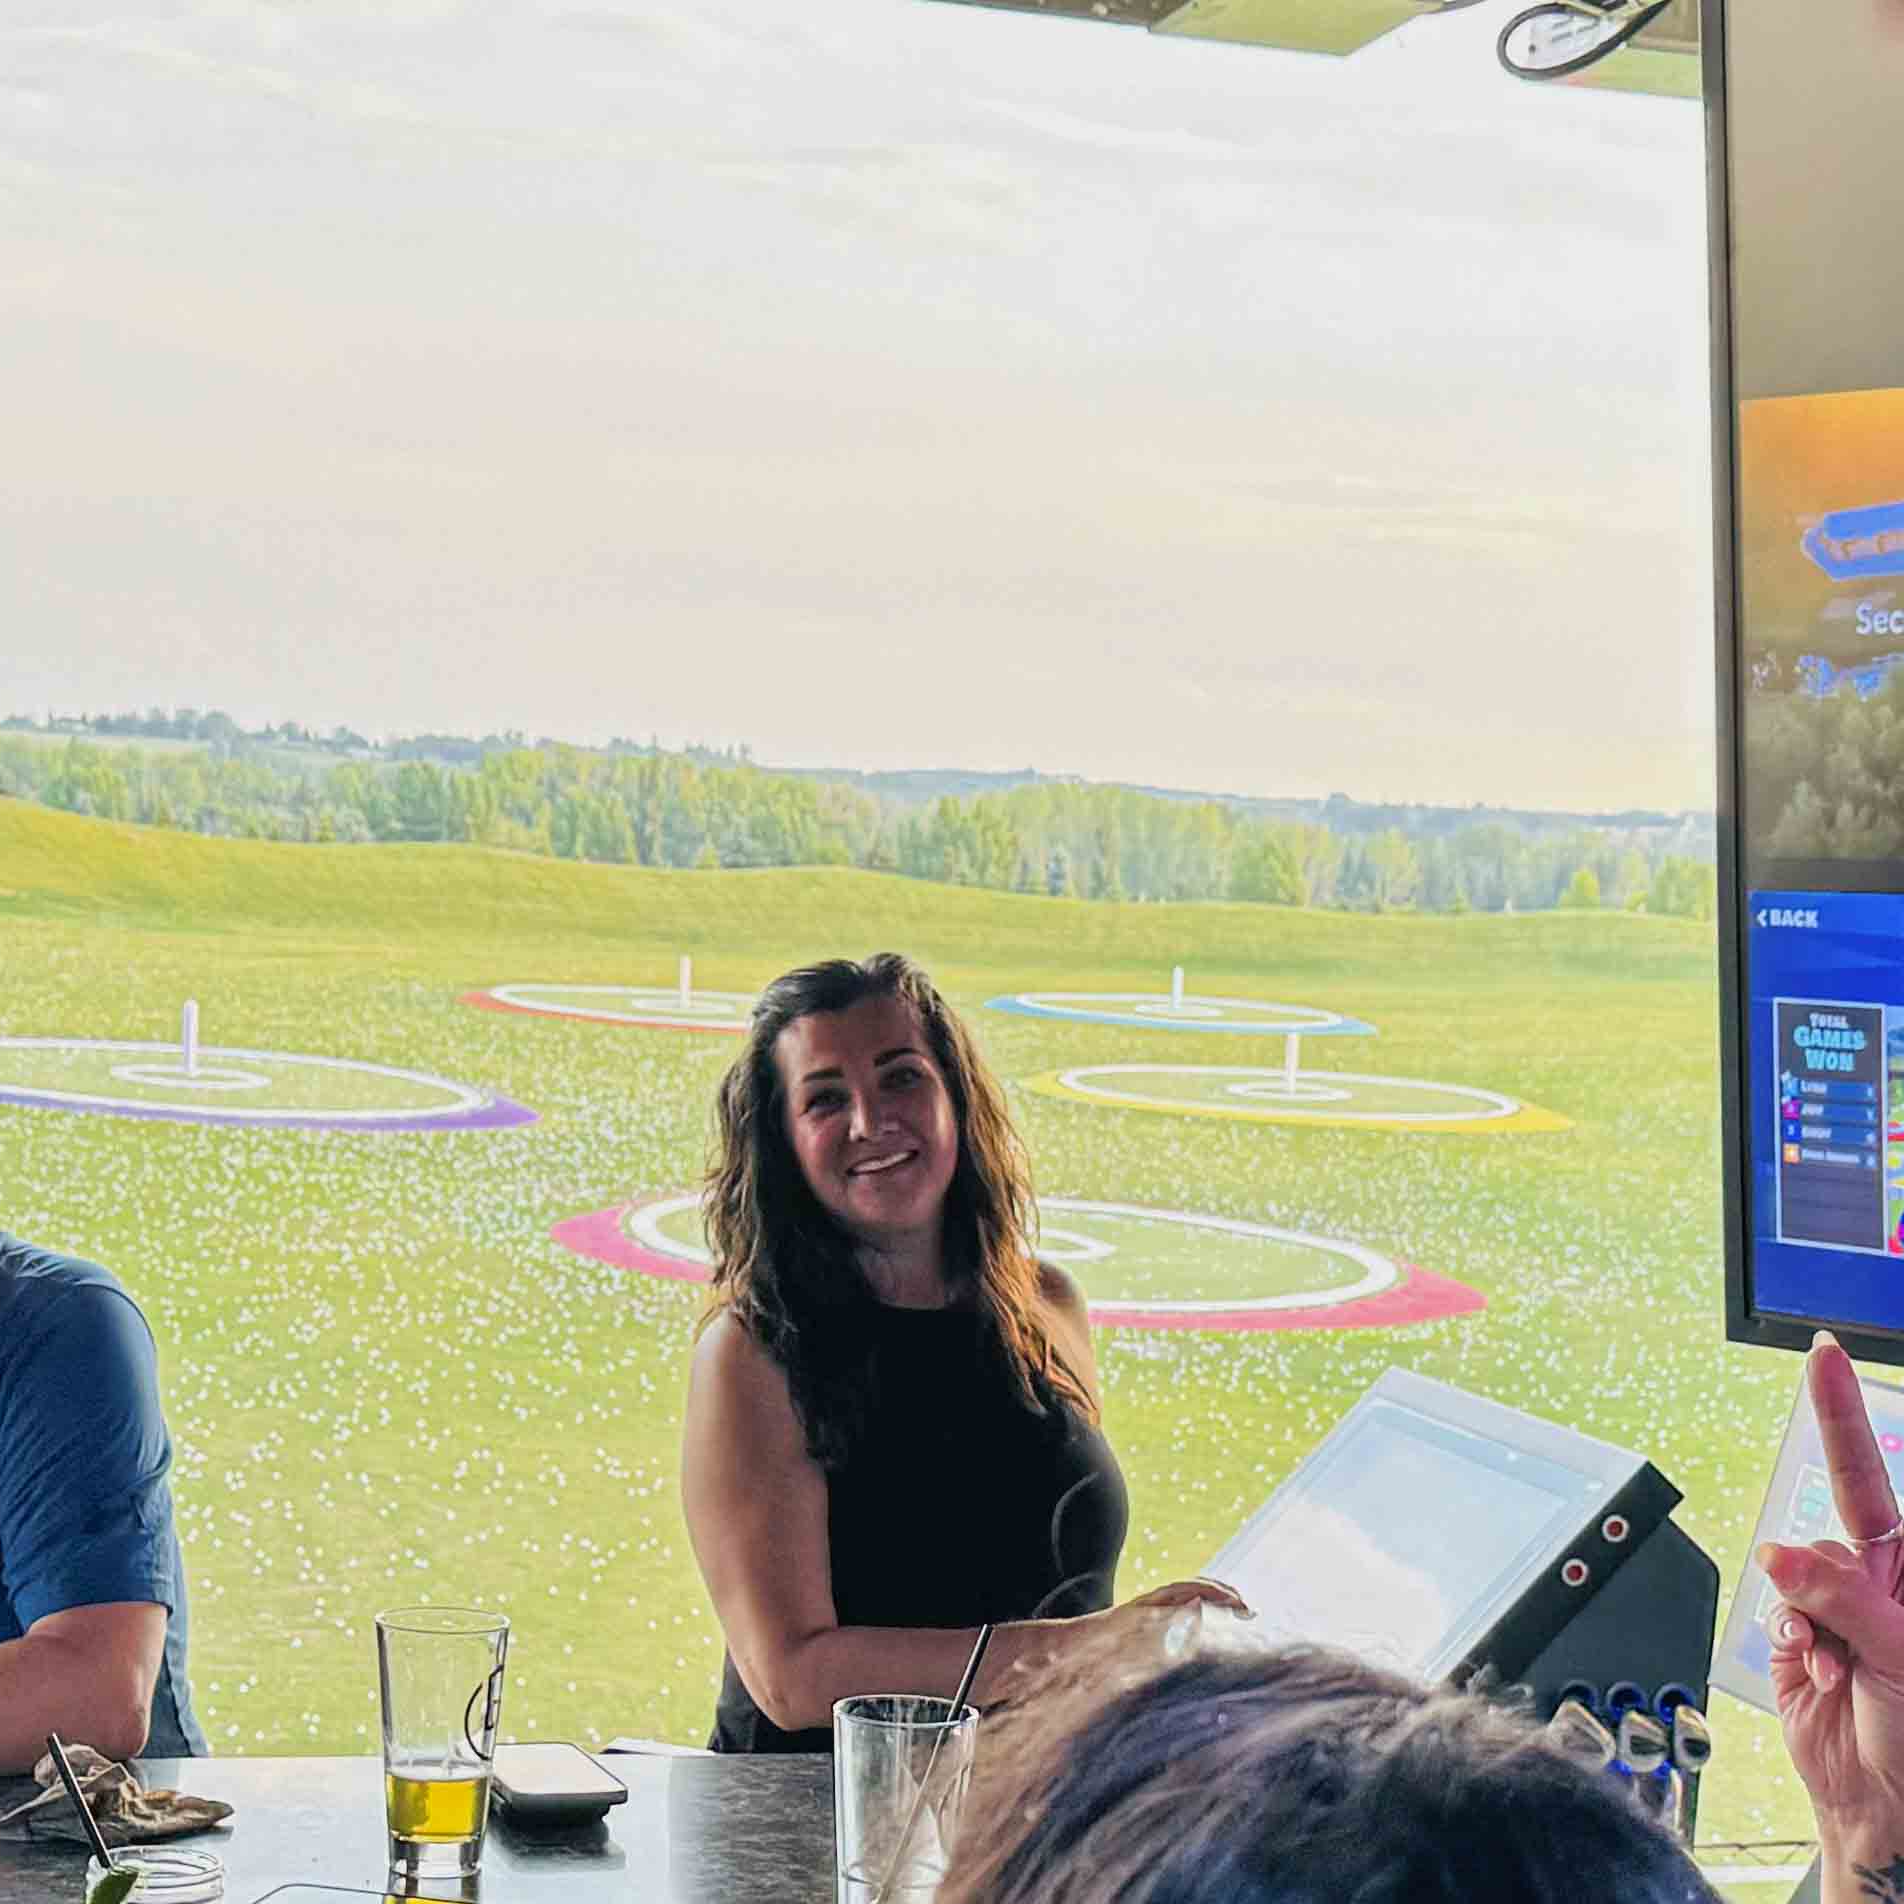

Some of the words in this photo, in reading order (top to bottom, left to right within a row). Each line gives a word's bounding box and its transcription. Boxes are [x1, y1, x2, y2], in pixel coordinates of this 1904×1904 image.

[1770, 909, 1818, 928] BACK
[1809, 1012, 1849, 1029] TOTAL
[1793, 1026, 1866, 1050] GAMES
[1805, 1049, 1856, 1072] WON
